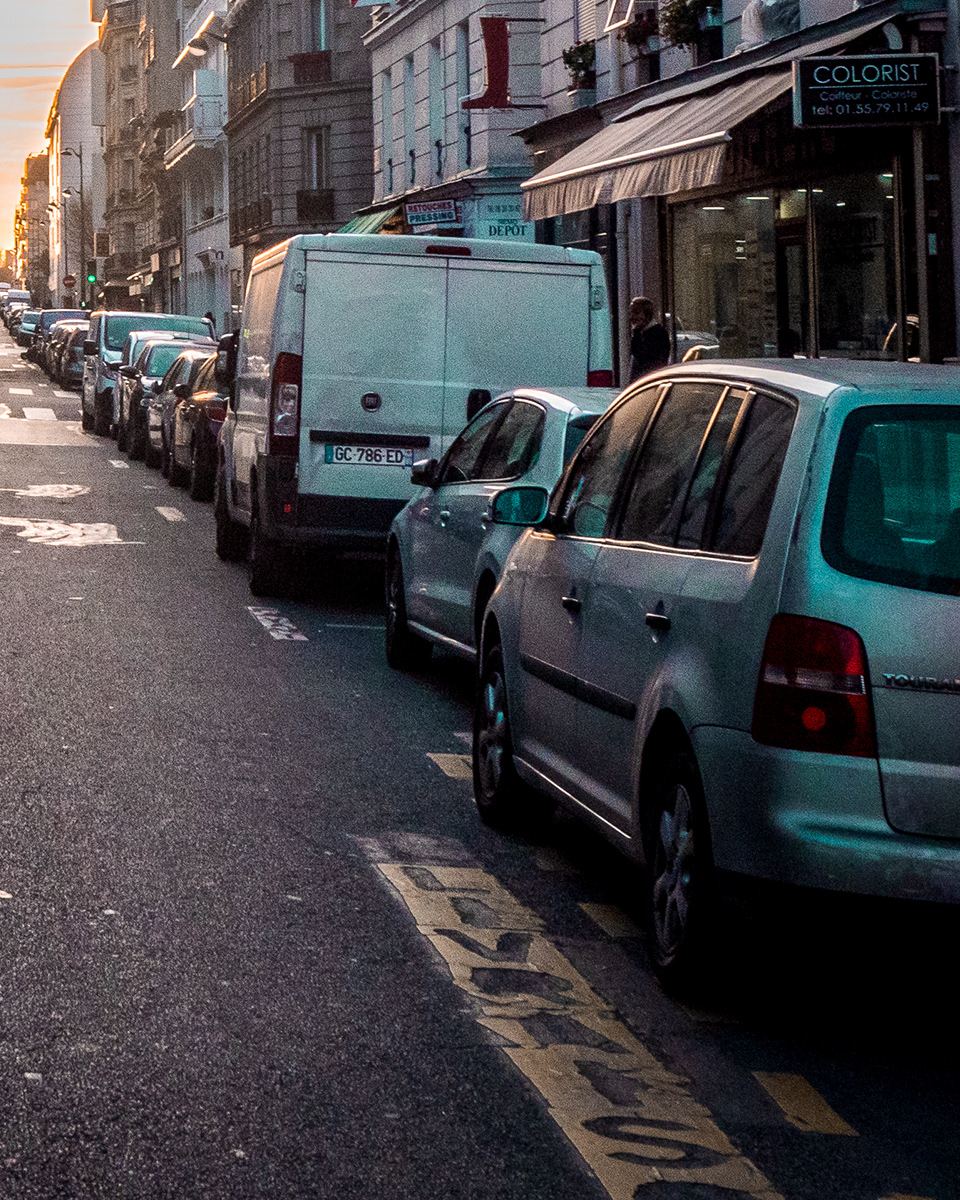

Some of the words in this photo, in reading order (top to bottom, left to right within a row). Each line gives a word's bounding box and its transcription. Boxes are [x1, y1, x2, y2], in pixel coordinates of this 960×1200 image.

[813, 63, 920, 84] COLORIST
[820, 90, 862, 101] Coiffeur
[871, 89, 918, 100] Coloriste
[835, 102, 929, 115] 01.55.79.11.49
[408, 202, 452, 212] RETOUCHES
[410, 211, 454, 222] PRESSING
[335, 447, 404, 463] GC-786-ED
[882, 672, 960, 691] TOURA
